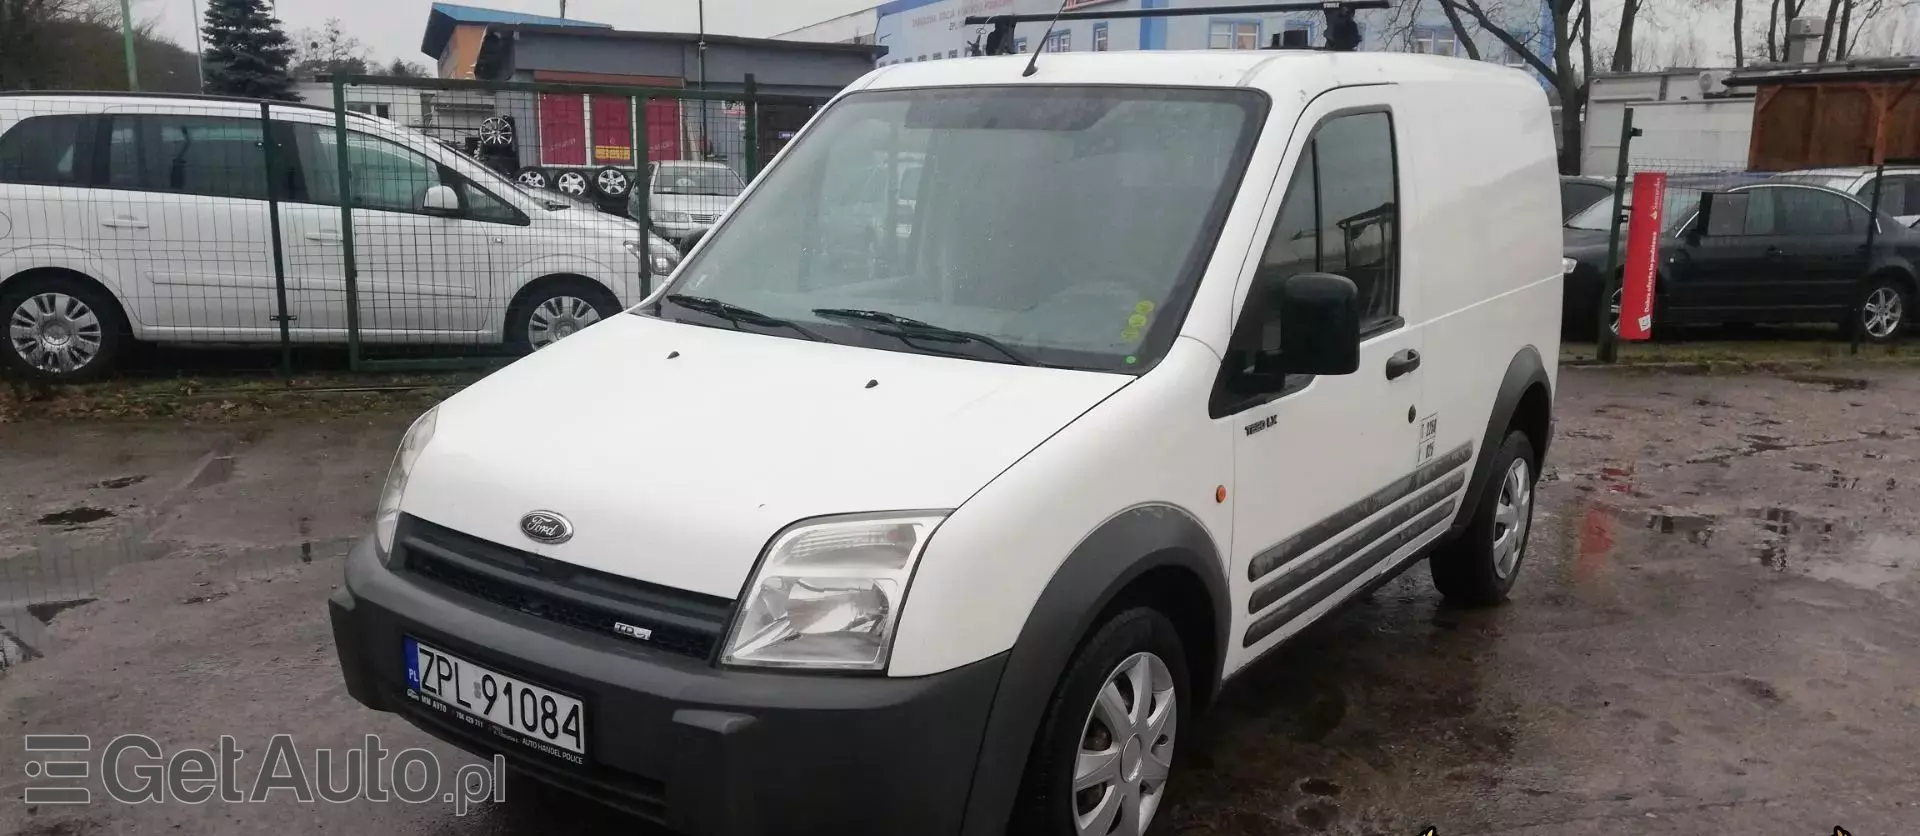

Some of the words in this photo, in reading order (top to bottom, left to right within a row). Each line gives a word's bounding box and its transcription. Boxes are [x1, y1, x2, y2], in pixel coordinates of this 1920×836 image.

[527, 515, 559, 536] Ford
[408, 668, 419, 682] PL
[418, 647, 472, 709] ZPL
[481, 673, 582, 750] 91084
[522, 738, 537, 750] AUTO
[538, 743, 561, 758] HANDEL
[562, 751, 583, 765] POLICE
